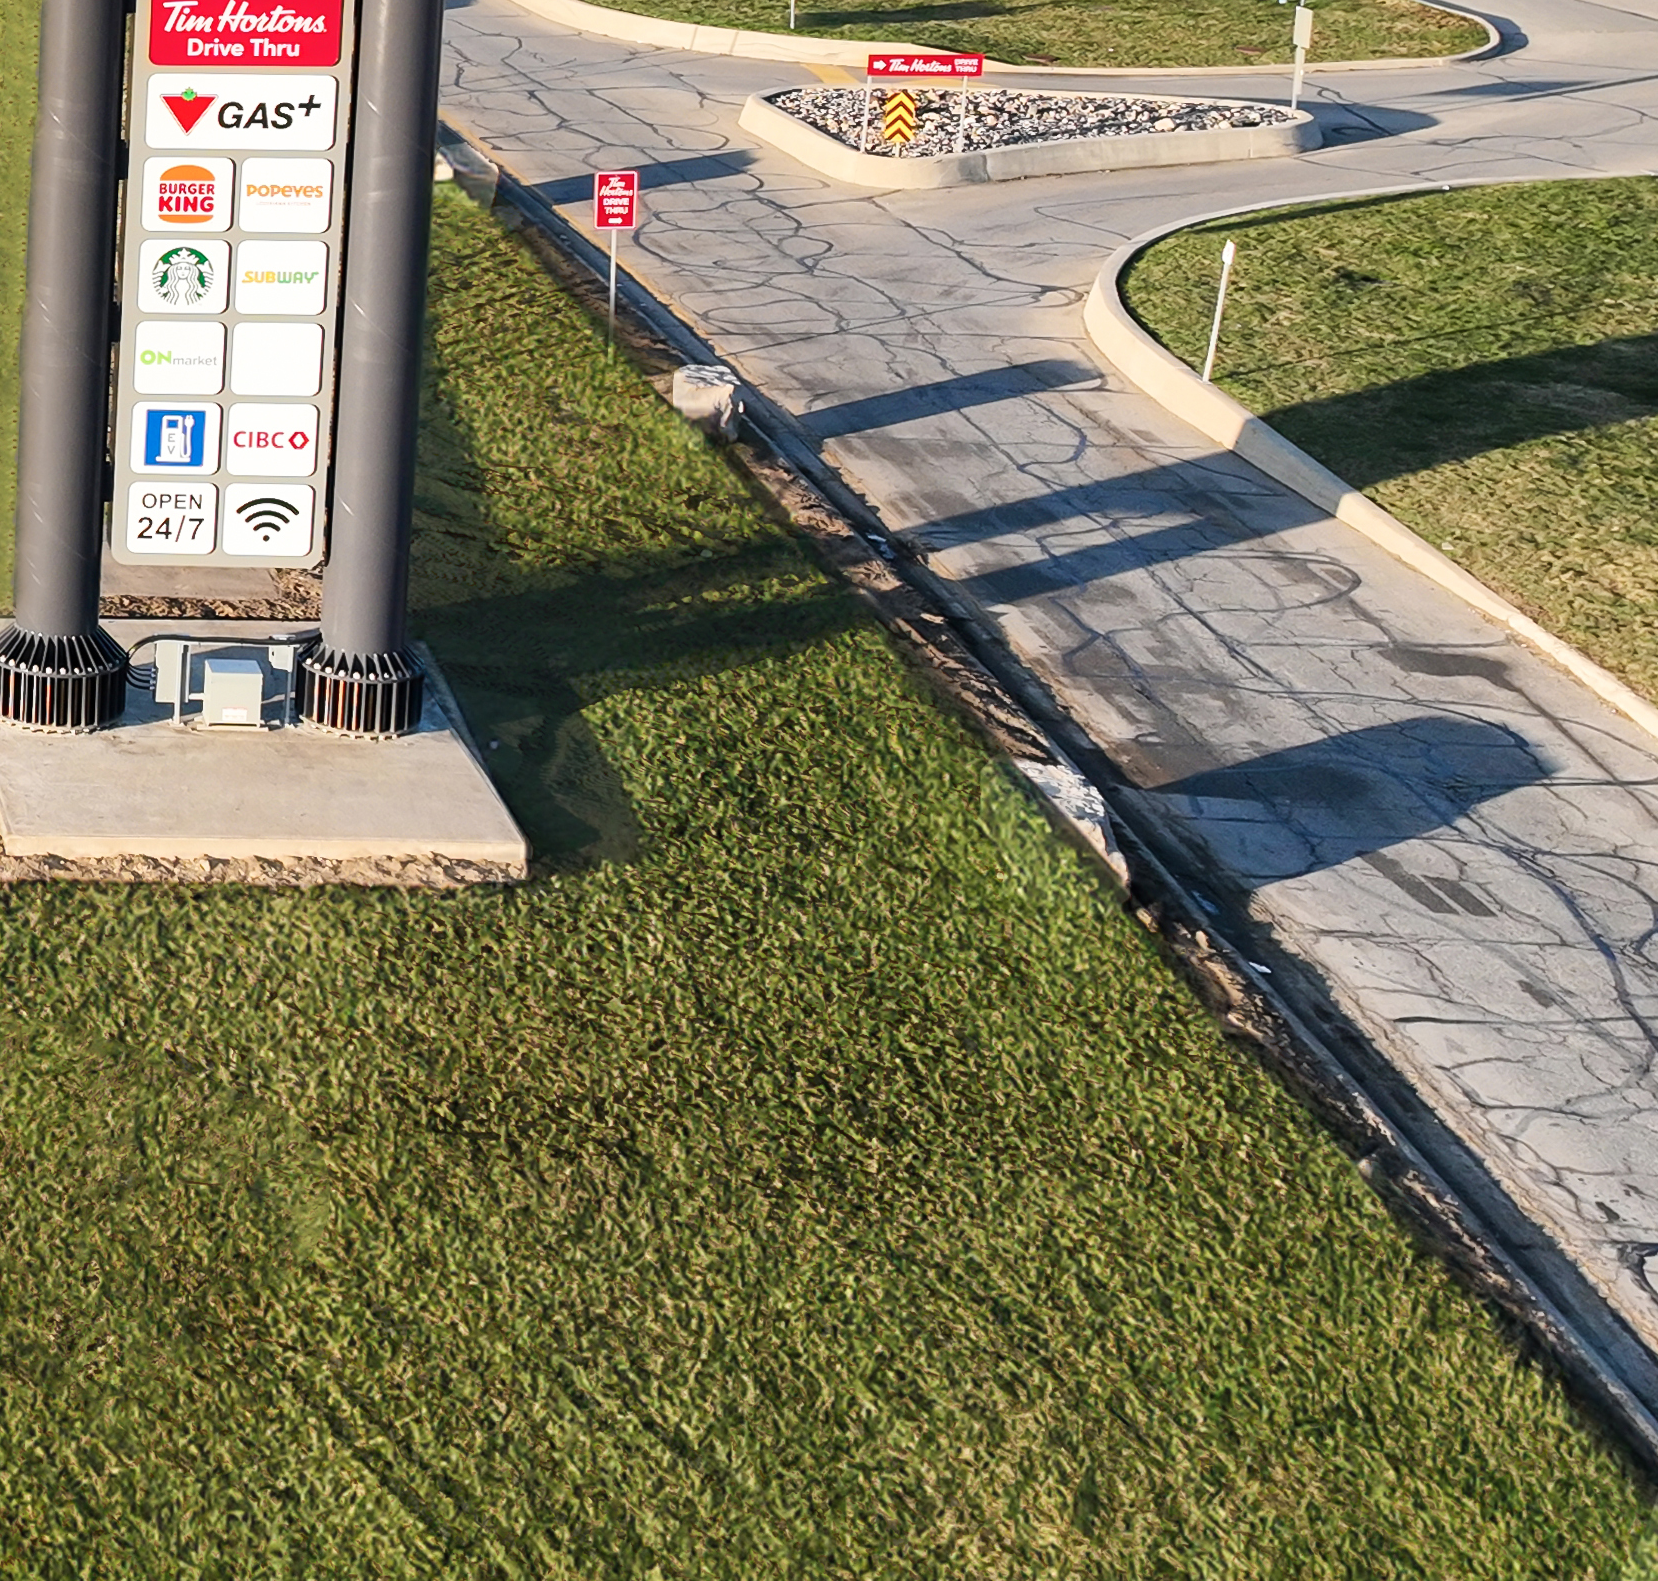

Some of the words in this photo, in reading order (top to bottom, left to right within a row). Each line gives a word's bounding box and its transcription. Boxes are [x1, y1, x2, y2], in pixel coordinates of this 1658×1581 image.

[163, 0, 213, 32] Tim
[216, 0, 327, 33] Hortons
[187, 38, 244, 57] Drive
[250, 37, 300, 57] Thru
[889, 59, 910, 72] Tim
[910, 59, 952, 72] Hortons
[159, 182, 215, 195] BURGER
[158, 196, 215, 213] KING
[603, 197, 630, 205] DRIVE
[604, 206, 629, 214] THRU
[241, 271, 319, 284] SUBWAY
[140, 350, 218, 367] ONmarket
[233, 431, 284, 448] CIBC
[142, 493, 203, 510] OPEN
[137, 515, 204, 542] 24/7
